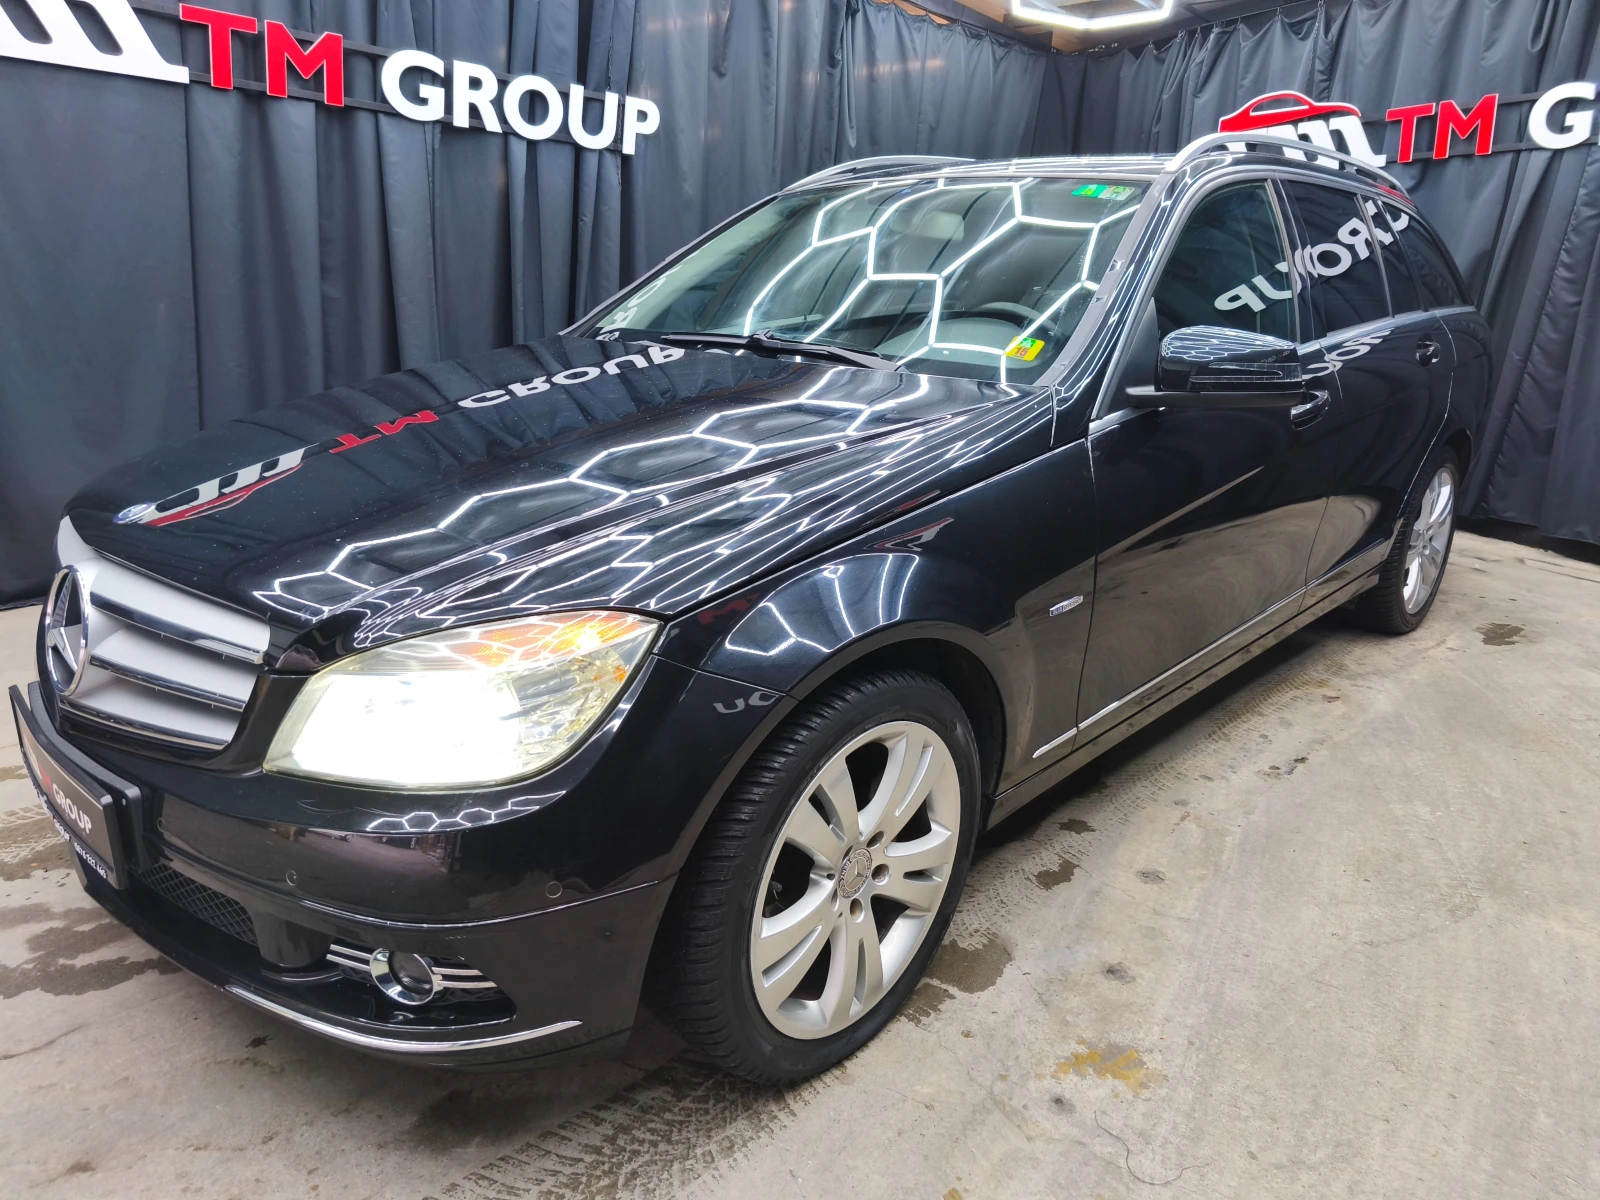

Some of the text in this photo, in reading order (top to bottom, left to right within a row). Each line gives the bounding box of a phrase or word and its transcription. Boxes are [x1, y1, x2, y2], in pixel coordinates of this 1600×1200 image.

[179, 3, 661, 155] TM GROUP
[1385, 93, 1498, 163] TM
[52, 783, 92, 835] GROUP
